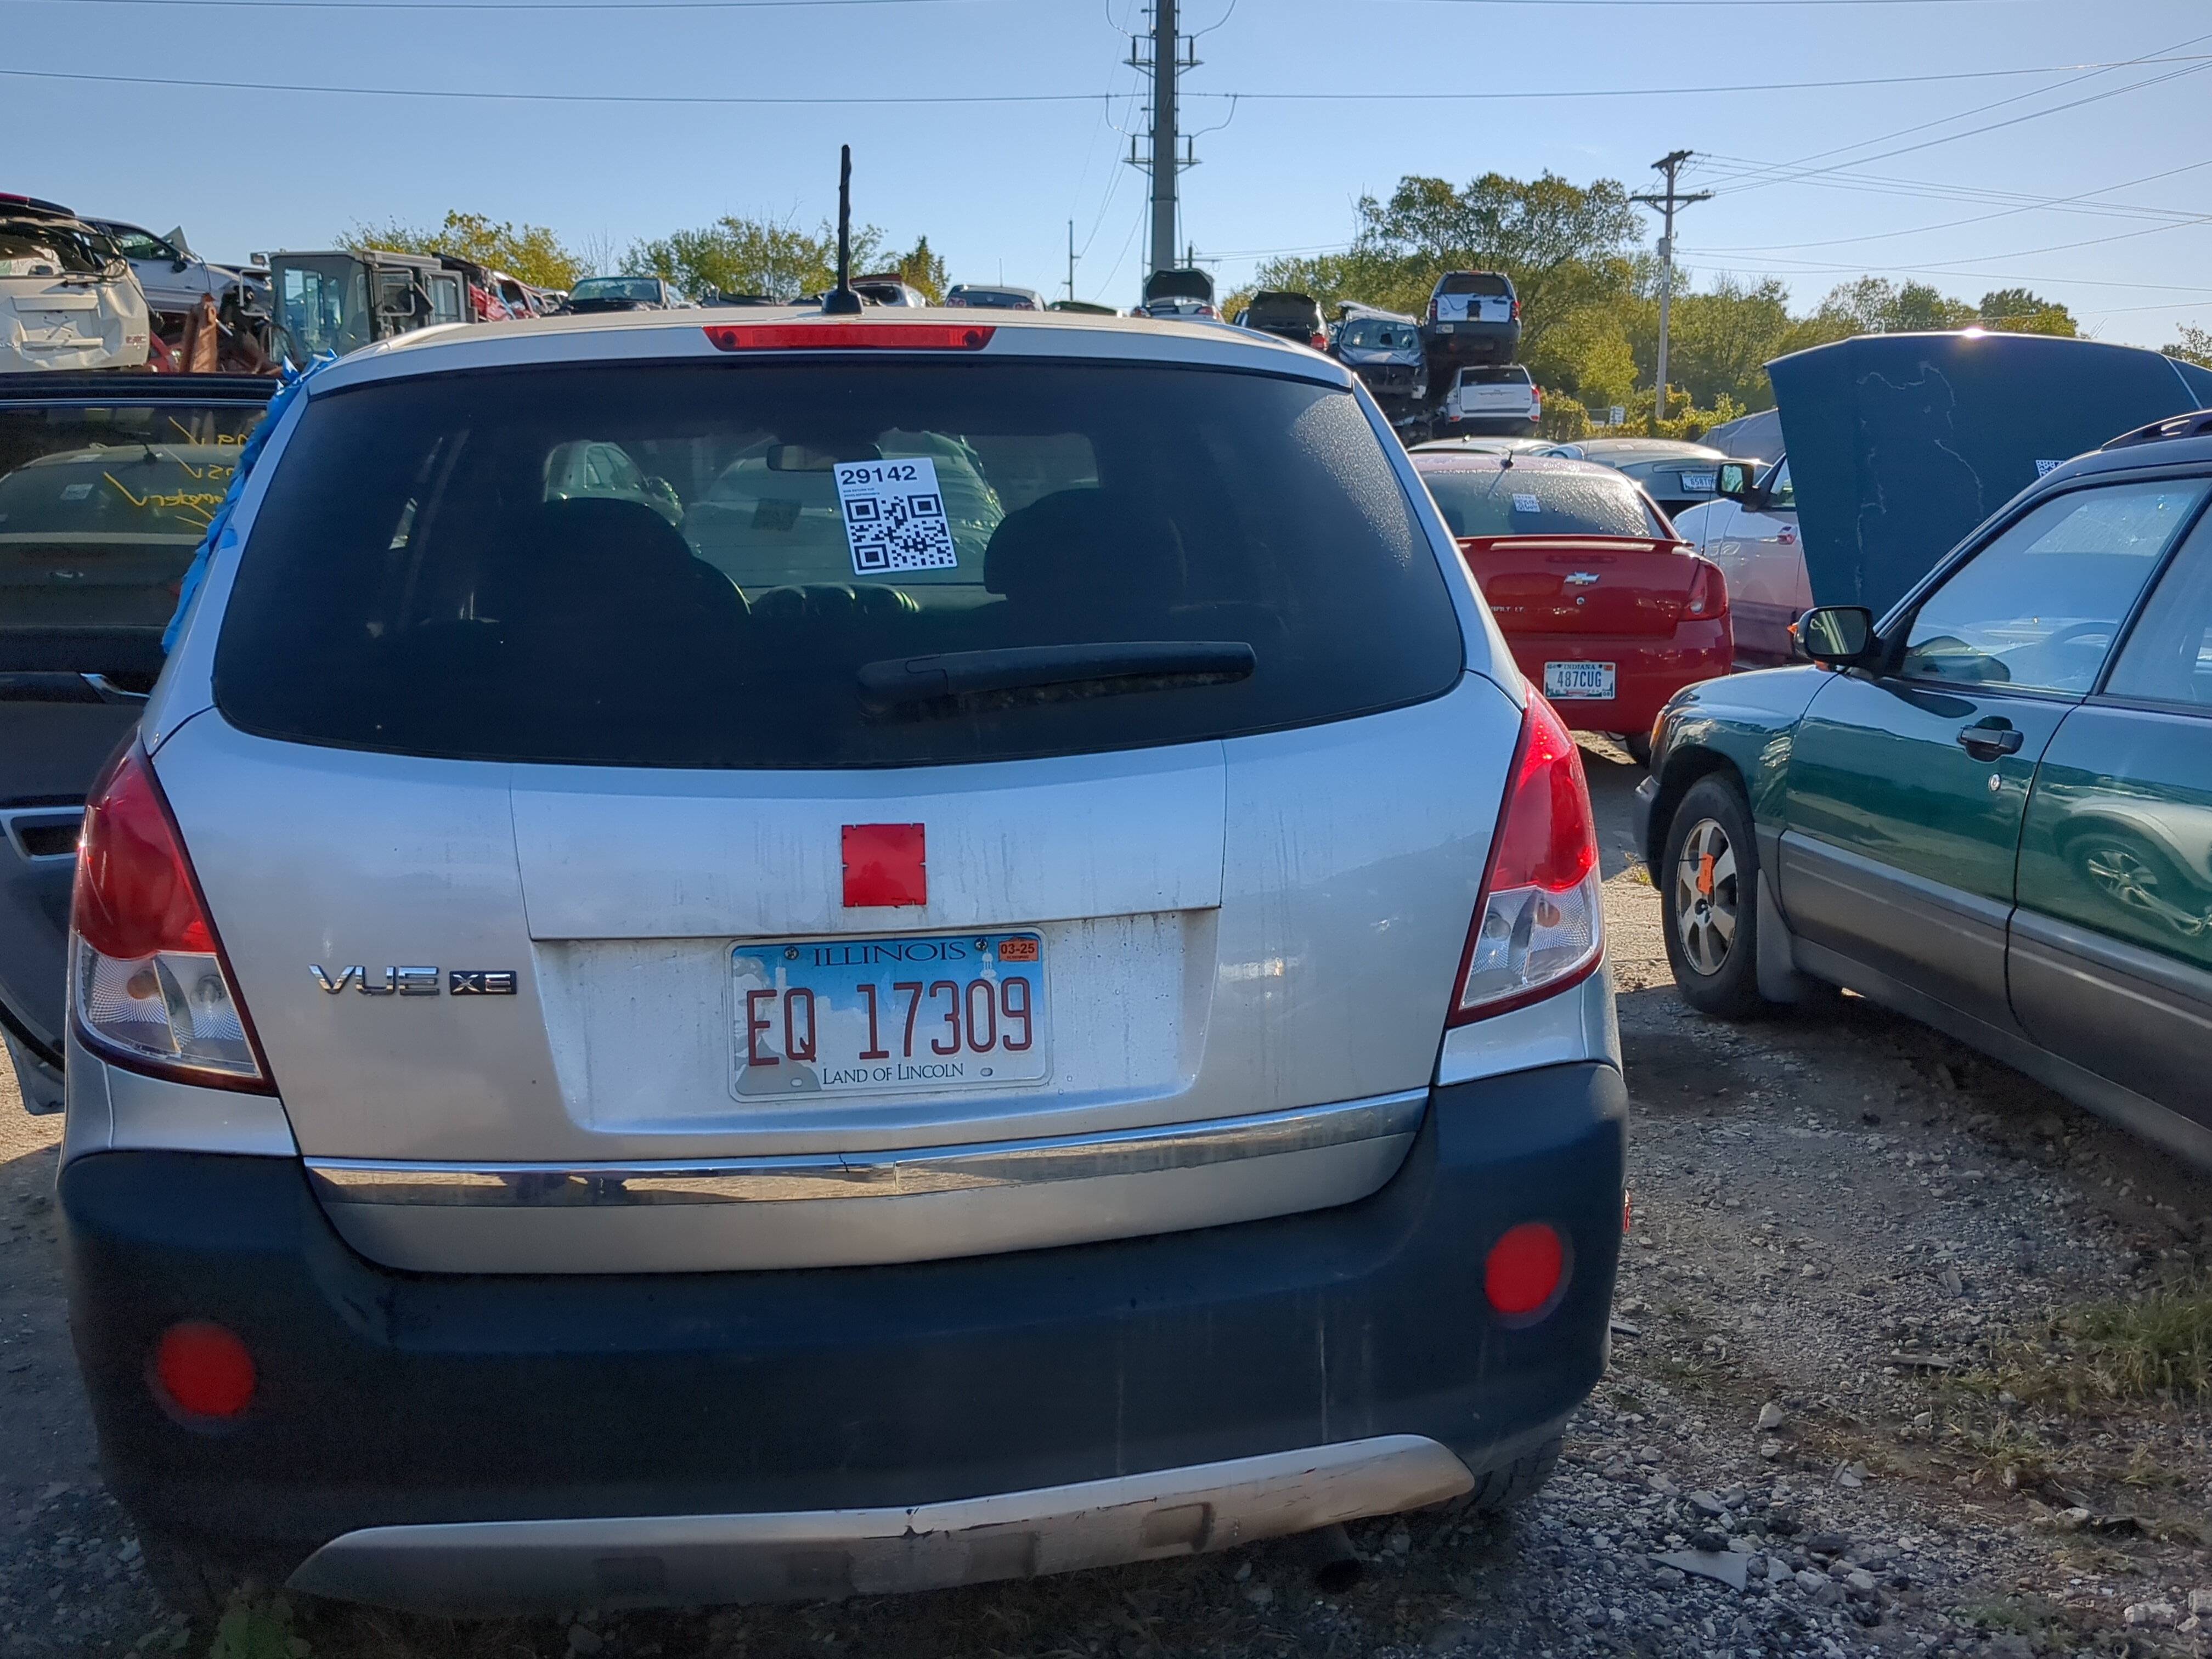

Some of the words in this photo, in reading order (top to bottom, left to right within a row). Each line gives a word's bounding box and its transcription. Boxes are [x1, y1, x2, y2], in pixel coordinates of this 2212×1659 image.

[840, 466, 917, 485] 29142
[1558, 671, 1601, 687] 487CUG
[814, 941, 967, 967] ILLINOIS
[1001, 943, 1035, 954] 03-25
[309, 964, 440, 996] VUE
[452, 974, 511, 993] XE
[746, 988, 816, 1066] EQ
[856, 977, 1032, 1059] 17309
[823, 1066, 868, 1085] LAND
[898, 1063, 963, 1081] LINCOLN
